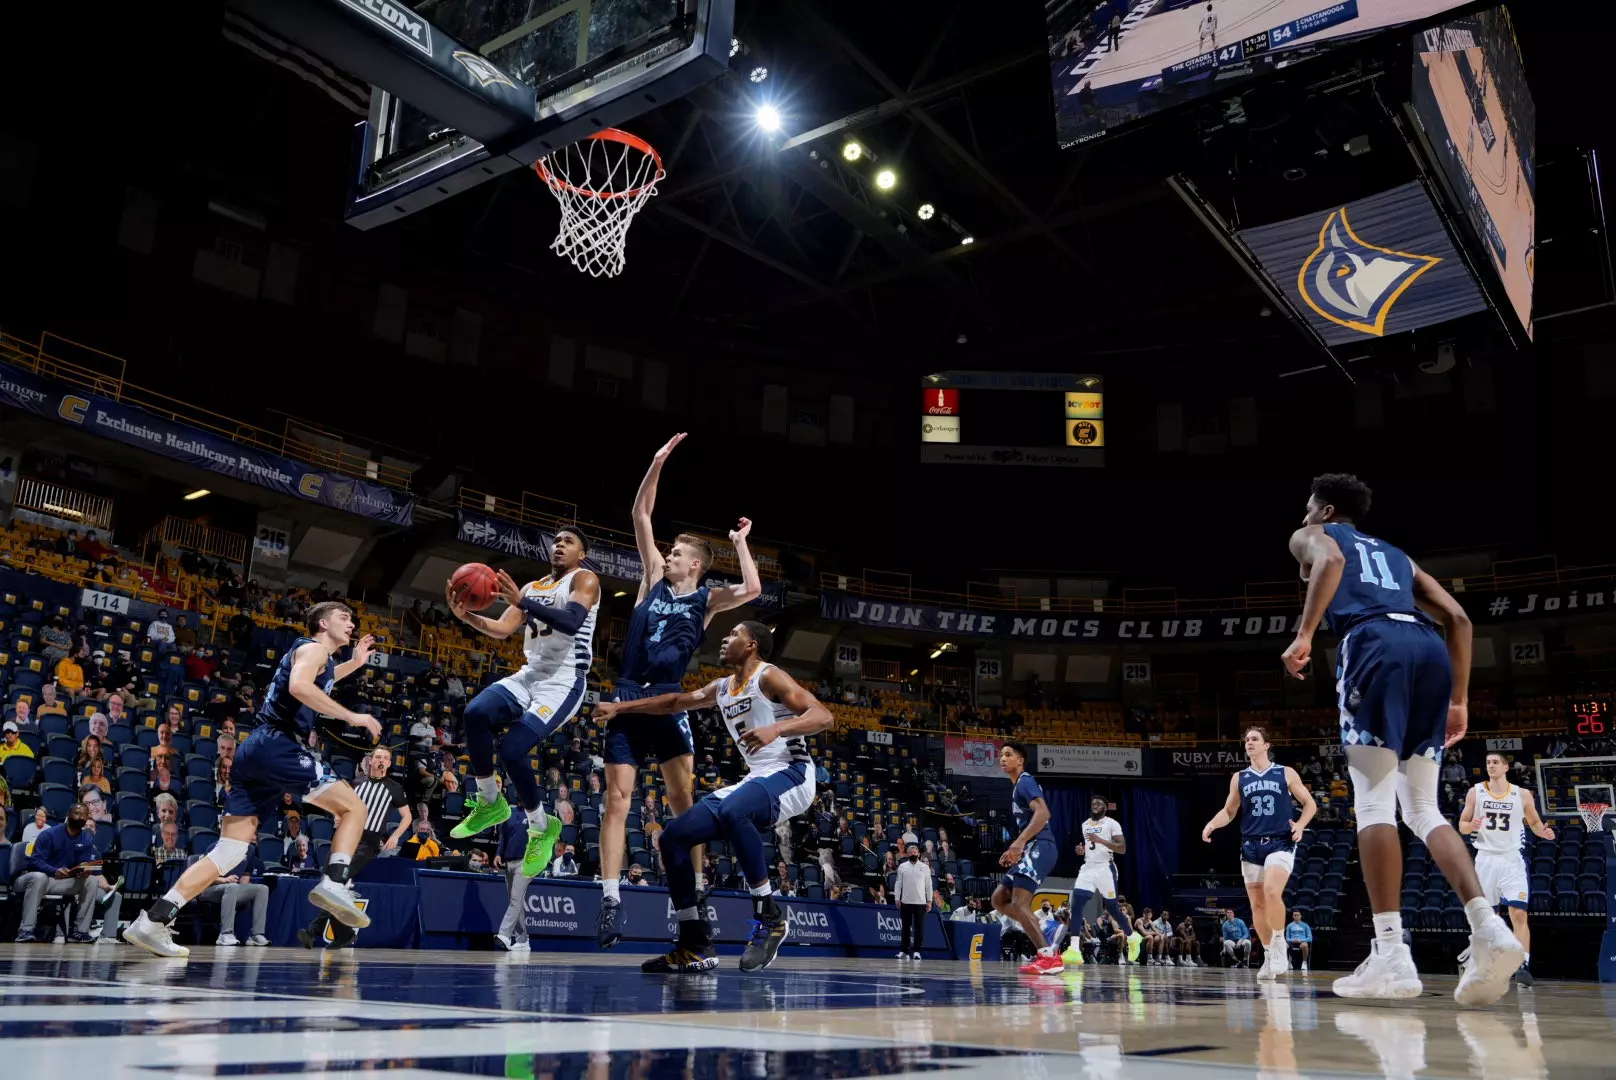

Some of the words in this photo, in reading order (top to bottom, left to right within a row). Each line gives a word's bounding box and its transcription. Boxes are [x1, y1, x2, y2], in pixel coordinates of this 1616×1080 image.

[359, 0, 422, 40] COM
[1300, 5, 1344, 25] CHATTANOOGA
[1245, 34, 1266, 47] 11:30
[1273, 26, 1292, 42] 54
[1220, 45, 1237, 60] 47
[1172, 63, 1184, 71] THE
[1185, 53, 1212, 67] CITADEL
[1061, 130, 1106, 149] DAKTRONICS
[95, 409, 163, 444] Exclusive
[165, 433, 236, 467] Healthcare
[238, 456, 293, 485] Provider
[354, 493, 404, 514] erlanger
[260, 528, 286, 548] 215
[601, 562, 615, 575] TV
[1354, 542, 1400, 590] 11
[92, 593, 119, 610] 114
[850, 600, 922, 626] JOIN
[937, 611, 996, 634] THE
[1011, 617, 1100, 637] MOCS
[1118, 619, 1203, 639] CLUB
[840, 646, 857, 661] 218
[1514, 644, 1540, 659] 221
[980, 660, 998, 675] 219
[723, 697, 751, 719] MOCS
[1574, 702, 1607, 713] 11:31
[1577, 714, 1604, 734] 26
[872, 733, 888, 743] 117
[1492, 740, 1515, 750] 121
[1172, 752, 1212, 767] RUBY
[1243, 780, 1282, 797] CITADEL
[1250, 795, 1275, 817] 33
[1483, 801, 1513, 811] MOCS
[1486, 813, 1511, 831] 33
[525, 916, 578, 931] Chattanooga
[786, 905, 829, 928] Acura
[668, 923, 678, 933] Of
